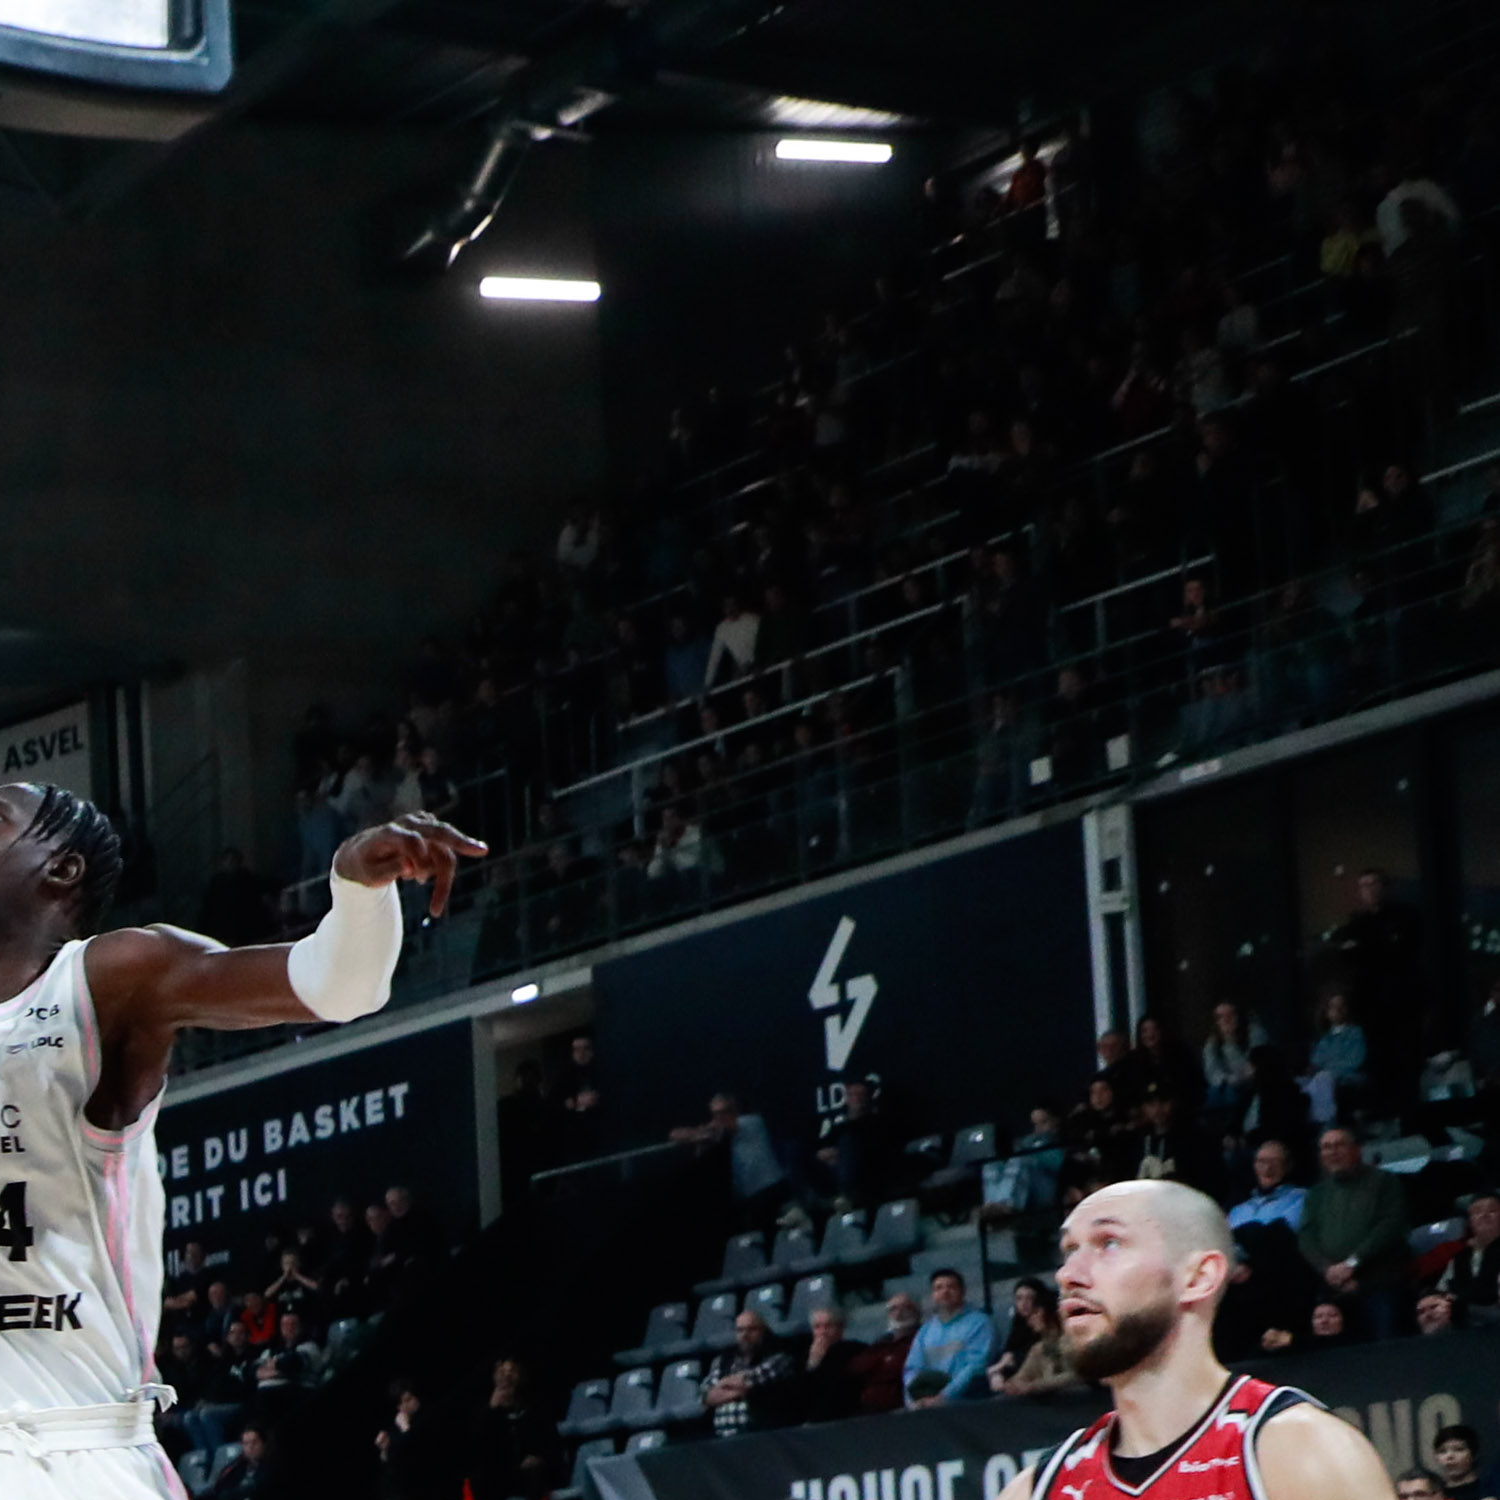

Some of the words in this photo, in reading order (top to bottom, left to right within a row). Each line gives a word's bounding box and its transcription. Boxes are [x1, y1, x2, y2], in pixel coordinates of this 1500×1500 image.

[3, 725, 84, 774] ASVEL
[204, 1127, 249, 1171] DU
[263, 1081, 410, 1154] BASKET
[164, 1185, 226, 1230] RIT
[240, 1168, 288, 1212] ICI
